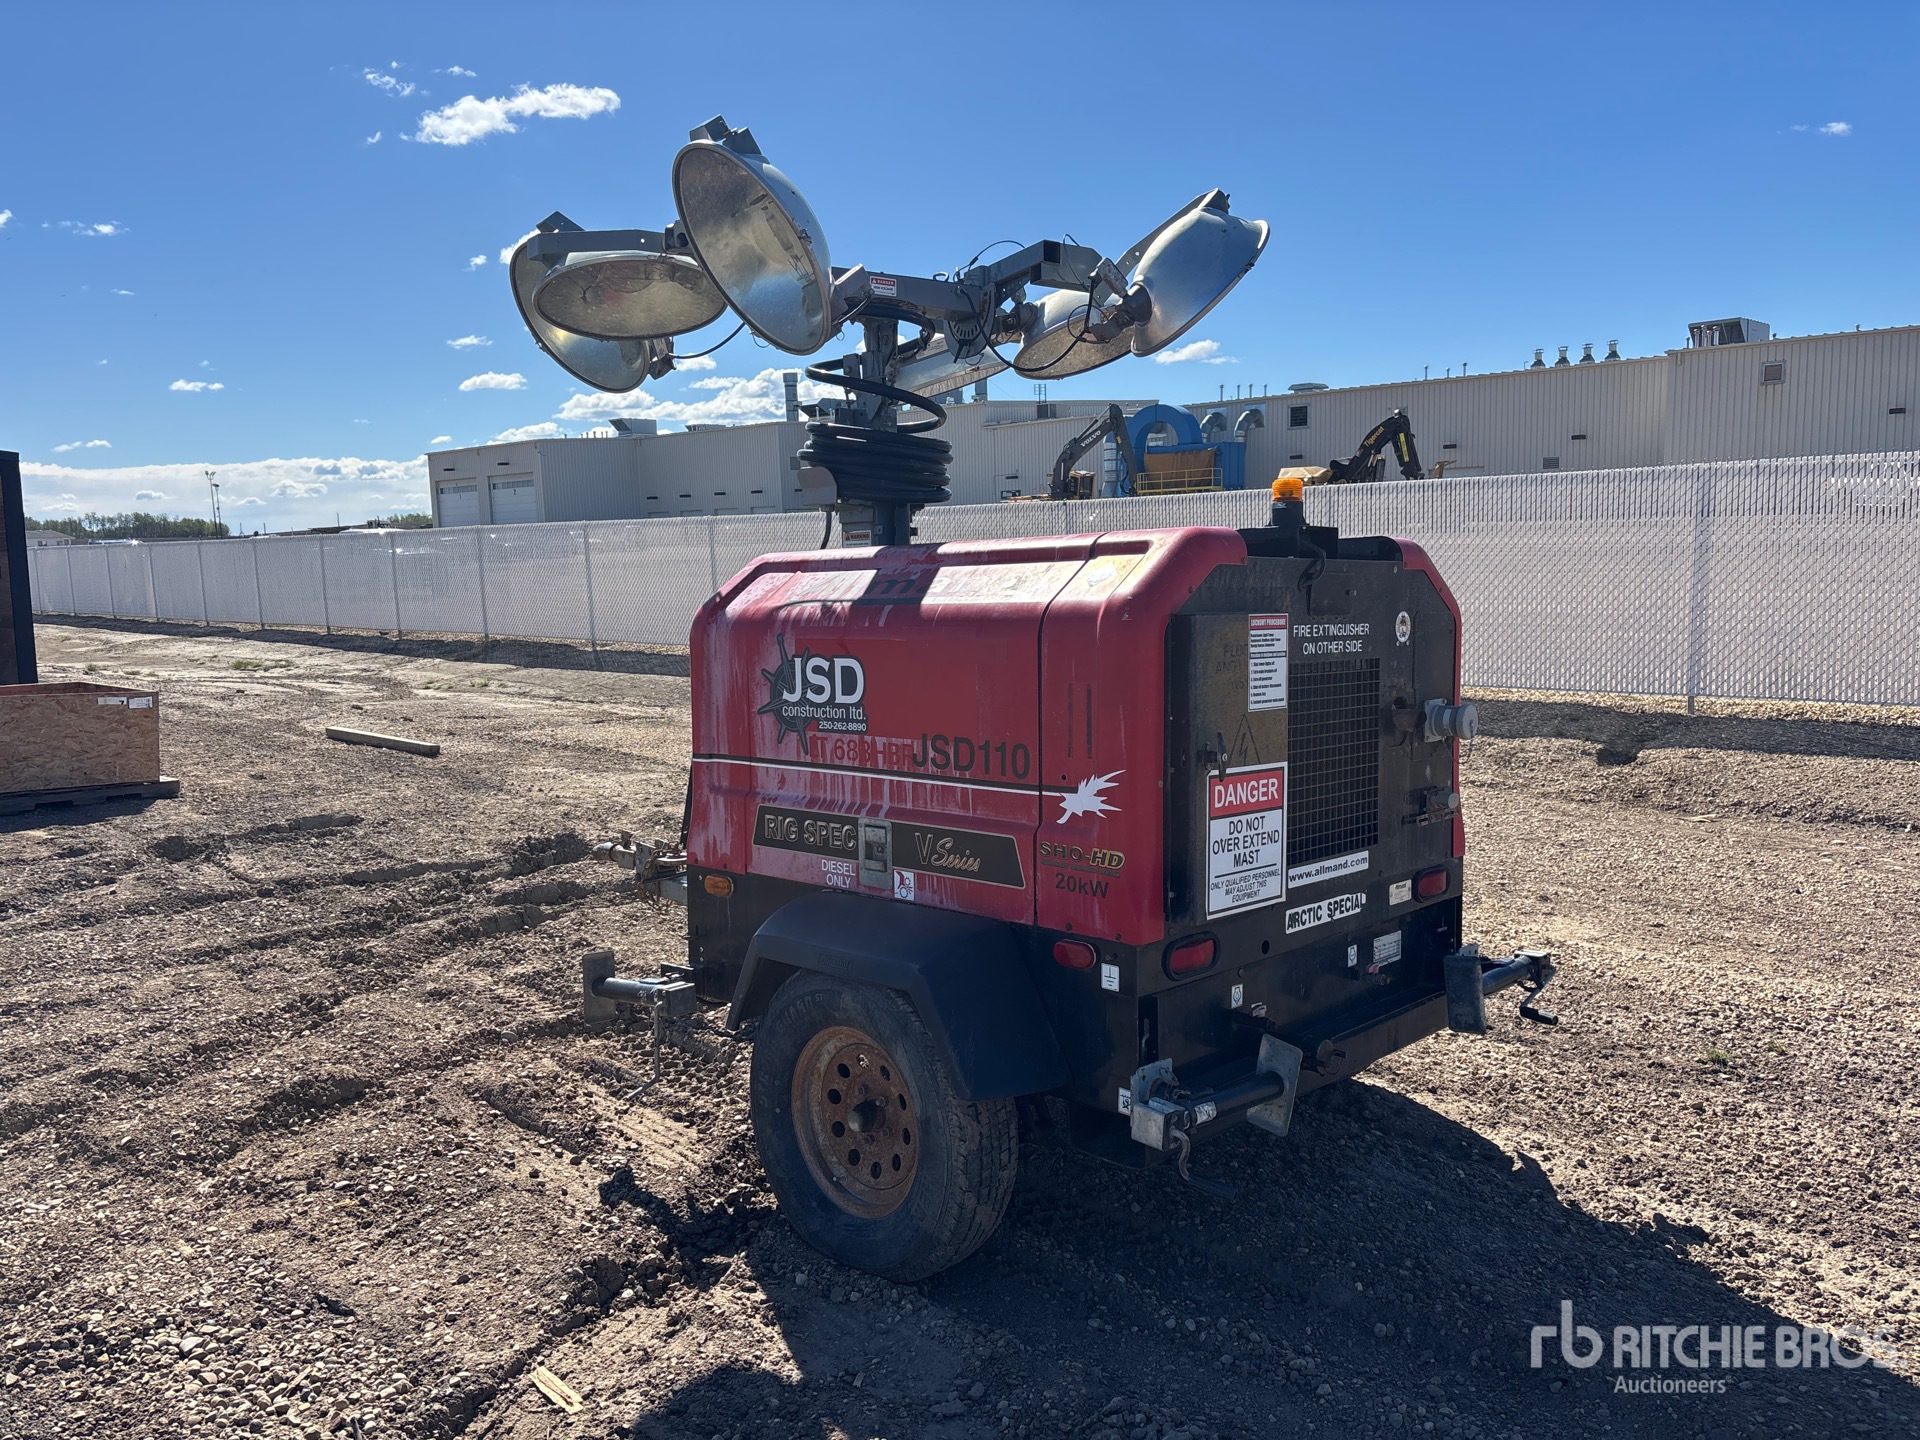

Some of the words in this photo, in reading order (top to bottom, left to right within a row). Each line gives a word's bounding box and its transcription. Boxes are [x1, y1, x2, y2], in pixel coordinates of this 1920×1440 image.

[1079, 430, 1102, 448] VOLVO
[1363, 425, 1385, 447] Tigercat
[1293, 625, 1311, 638] FIRE
[1312, 623, 1370, 637] EXTINGUISHER
[1303, 642, 1315, 655] ON
[1316, 641, 1344, 654] OTHER
[1345, 640, 1363, 653] SIDE
[782, 657, 864, 704] JSD
[782, 704, 846, 719] construction
[849, 705, 867, 720] ltd.
[819, 721, 867, 732] 250-262-8890
[912, 733, 1030, 780] JSD110
[1213, 777, 1279, 809] DANGER
[764, 814, 799, 842] RIG
[803, 819, 857, 851] SPEC
[1228, 819, 1243, 836] DO
[1246, 815, 1266, 832] NOT
[914, 832, 934, 865] V
[930, 837, 981, 872] Series
[1212, 836, 1240, 855] OVER
[1242, 829, 1280, 850] EXTEND
[1040, 841, 1126, 870] SHO-HD
[1233, 849, 1261, 868] MAST
[821, 859, 856, 877] DIESEL
[1288, 856, 1368, 883] www.allmand.com
[826, 874, 851, 889] ONLY
[1055, 872, 1110, 899] 20kW
[1210, 879, 1225, 891] ONLY
[1225, 874, 1251, 887] QUALIFIED
[1251, 869, 1281, 882] PERSONNEL
[1225, 886, 1236, 896] MAY
[1236, 881, 1257, 893] ADJUST
[1256, 879, 1267, 890] THIS
[1231, 889, 1261, 903] EQUIPMENT
[1286, 904, 1323, 931] ARCTIC
[1326, 892, 1364, 919] SPECIAL
